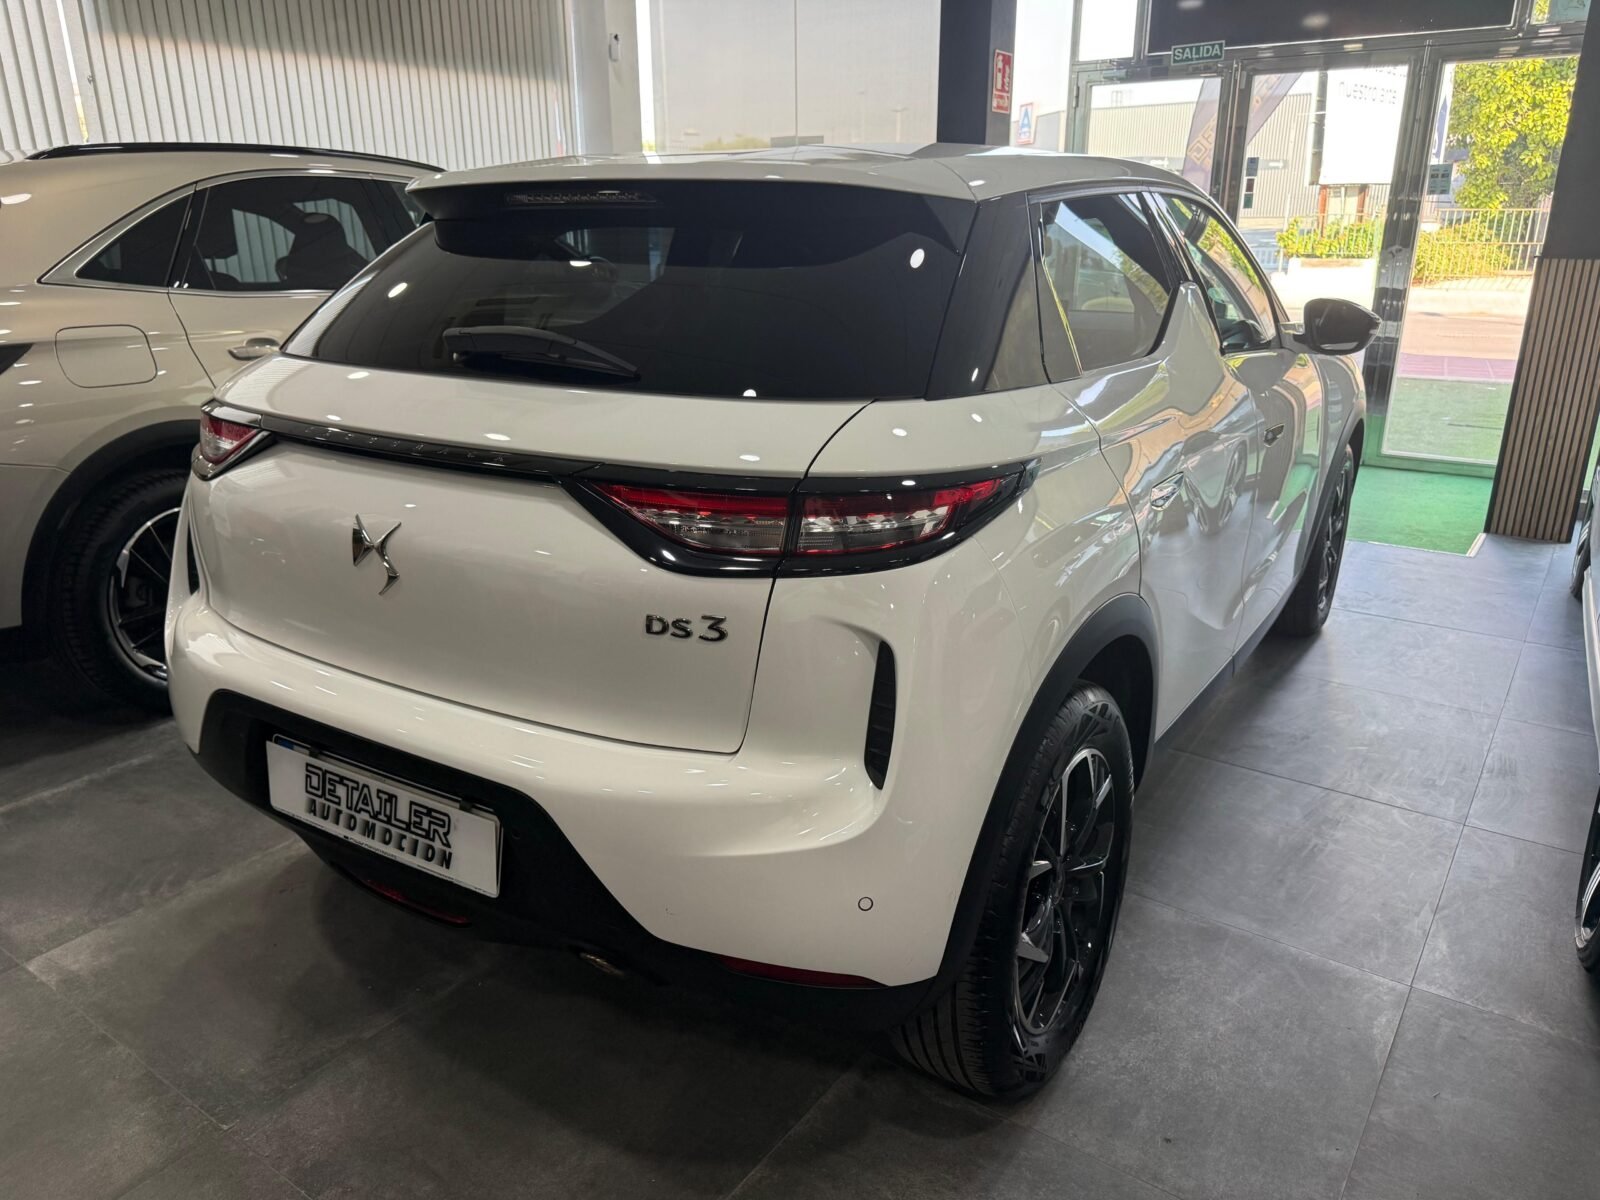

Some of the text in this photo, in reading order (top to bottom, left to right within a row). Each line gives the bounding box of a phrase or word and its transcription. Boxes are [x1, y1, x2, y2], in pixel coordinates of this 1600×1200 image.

[1174, 44, 1221, 60] SALIDA
[645, 613, 729, 642] DS 3
[305, 762, 452, 848] DETAILER
[305, 797, 453, 870] AUTOMOCION
